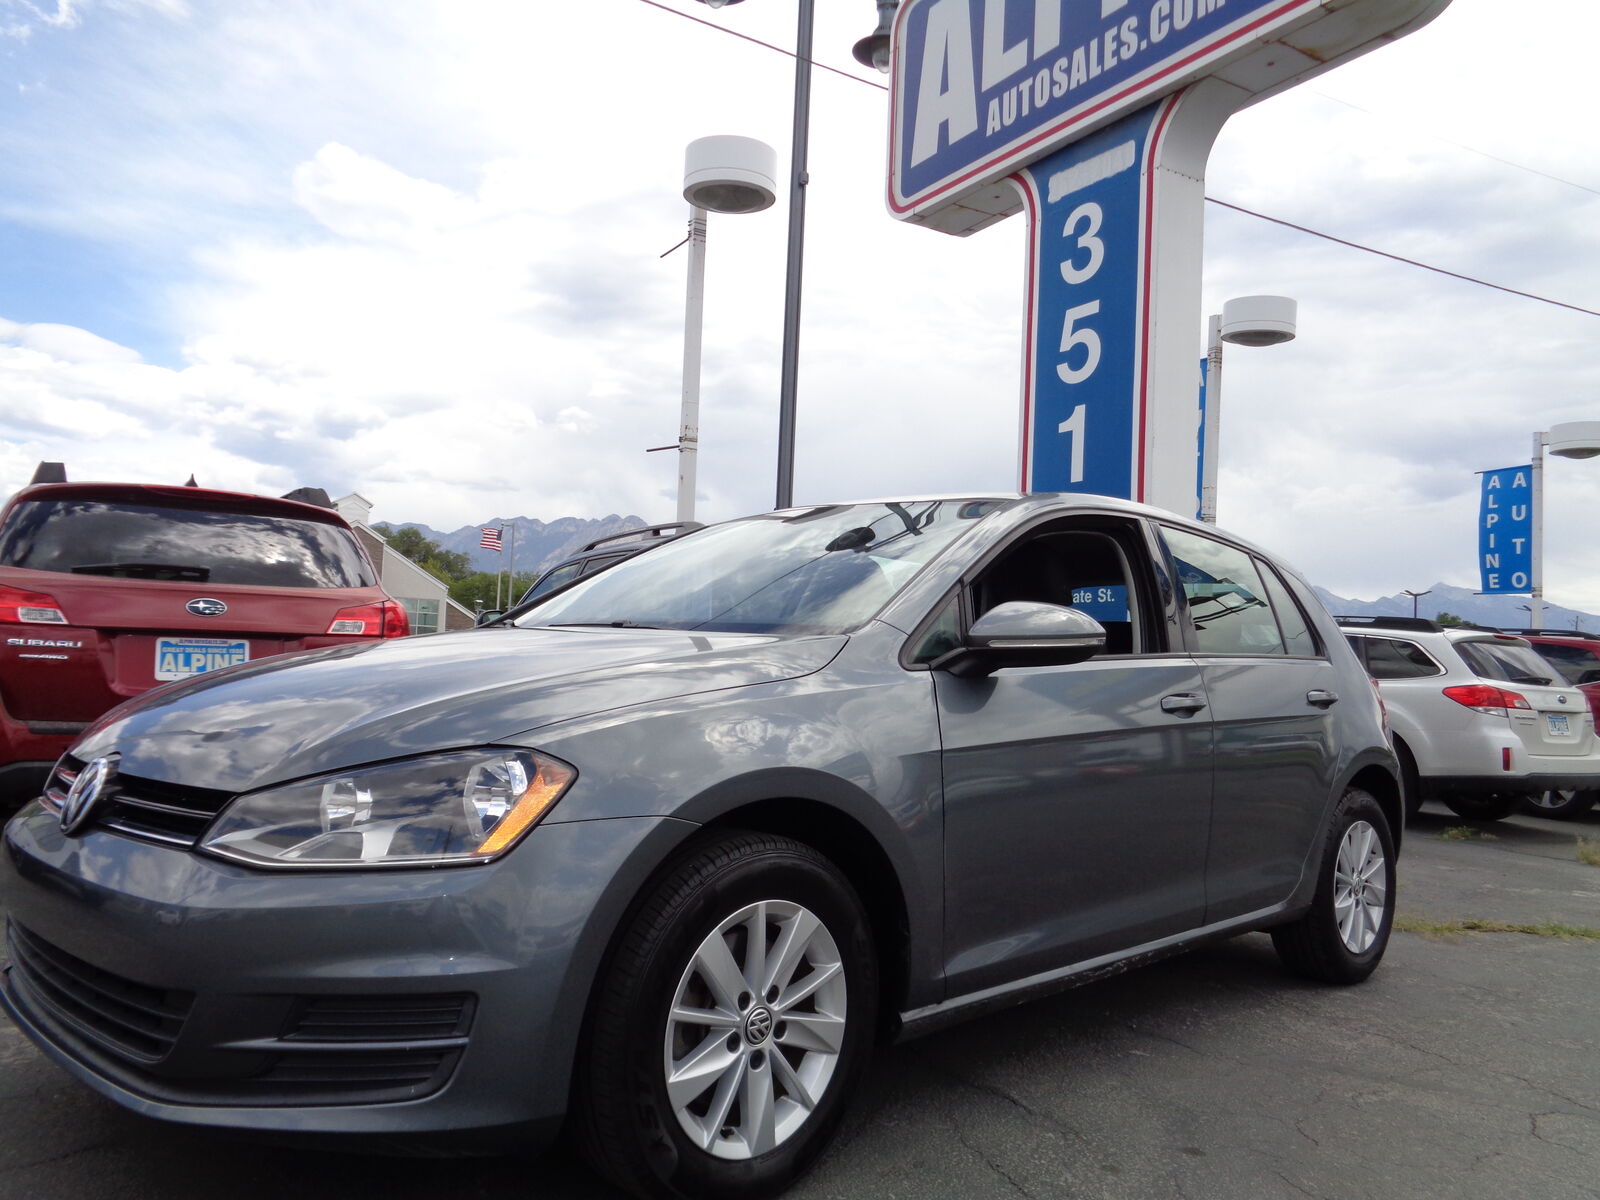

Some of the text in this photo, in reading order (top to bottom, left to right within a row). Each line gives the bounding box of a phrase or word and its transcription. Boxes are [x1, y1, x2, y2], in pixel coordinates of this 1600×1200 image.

[1485, 475, 1501, 588] ALPINE
[1511, 472, 1527, 589] AUTO
[1072, 588, 1115, 603] ate St.
[7, 638, 83, 648] SUBARU
